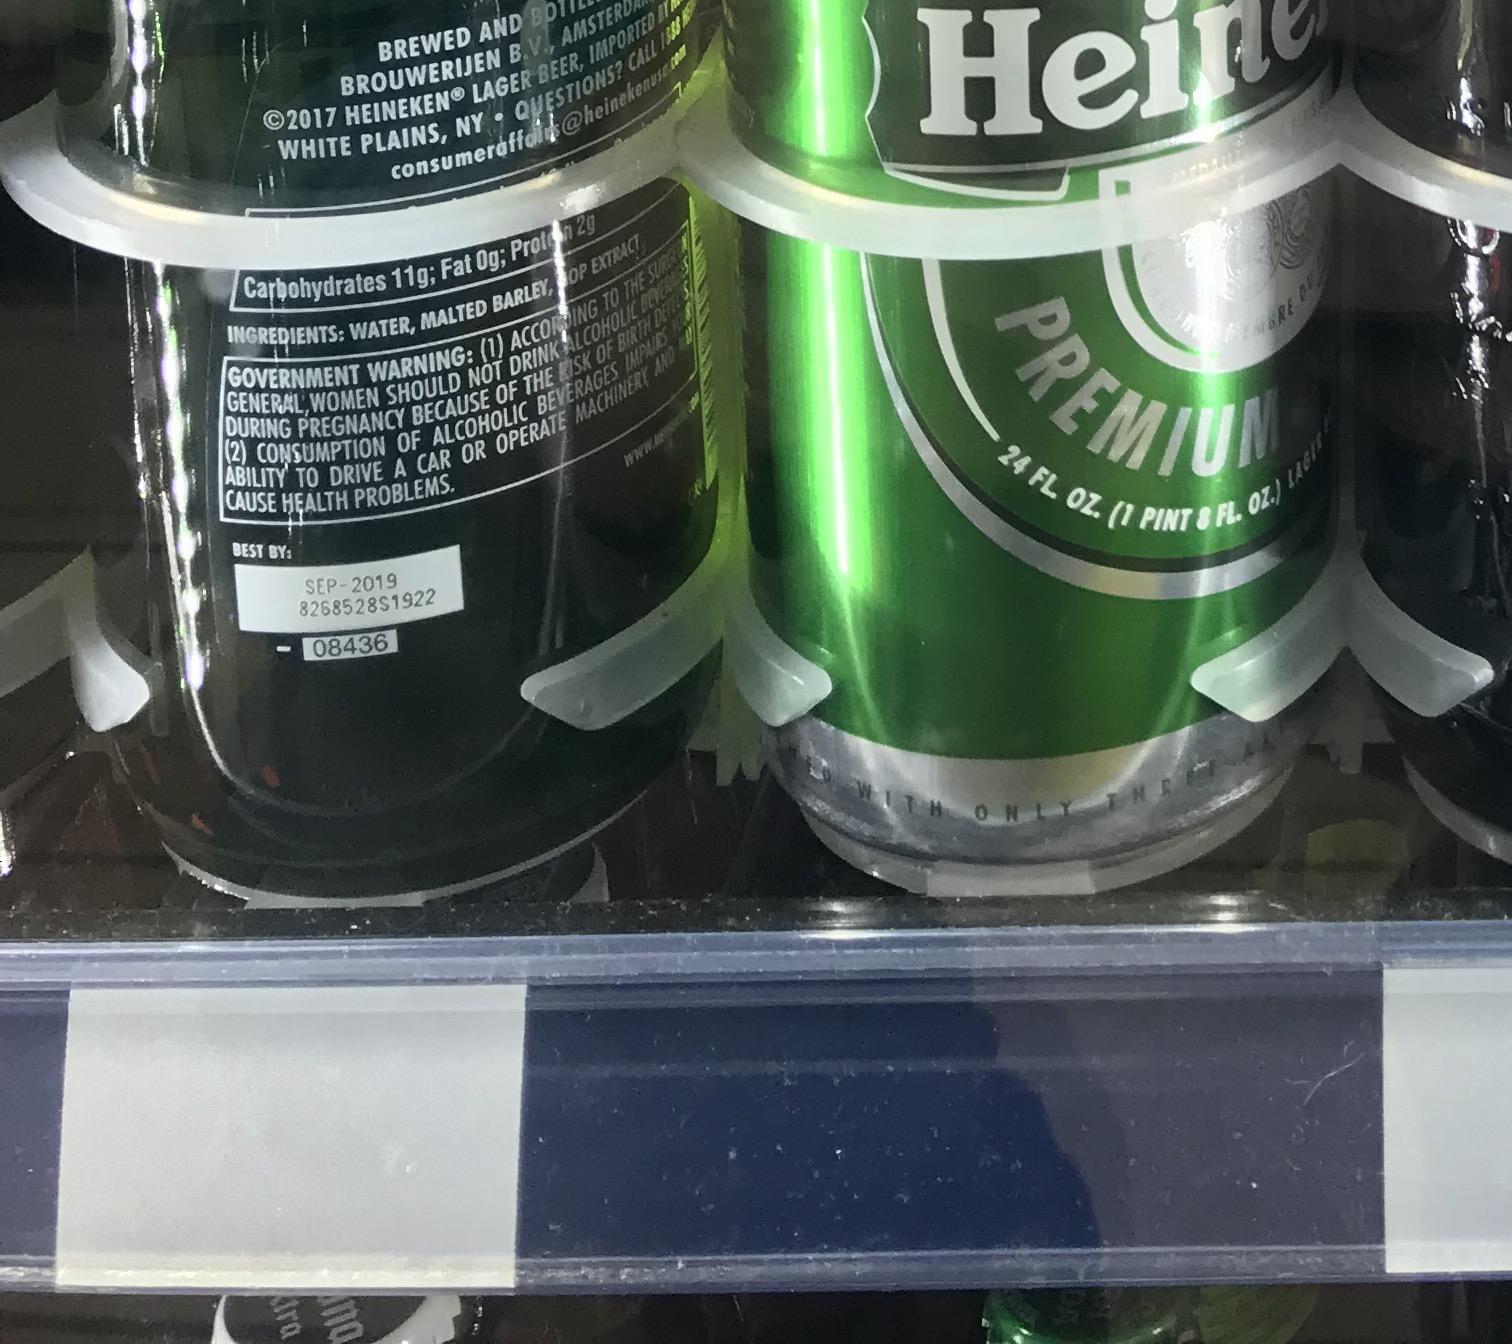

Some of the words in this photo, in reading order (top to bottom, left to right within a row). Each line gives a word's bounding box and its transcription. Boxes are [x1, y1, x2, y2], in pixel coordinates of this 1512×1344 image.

[378, 26, 472, 62] BREWED
[479, 13, 523, 43] AND
[340, 47, 501, 97] BROUWERIJEN
[472, 69, 533, 104] LAGER
[278, 135, 352, 161] WHITE
[360, 121, 448, 155] PLAINS,
[455, 111, 484, 139] NY
[243, 273, 387, 303] Carbohydrates
[441, 253, 473, 280] Fat
[227, 324, 345, 346] INGREDIENTS:
[349, 315, 416, 341] WATER,
[421, 299, 488, 331] MALTED
[228, 363, 361, 390] GOVERNMENT
[367, 344, 474, 384] WARNING:
[310, 386, 380, 414] WOMEN
[386, 371, 461, 406] SHOULD
[468, 360, 503, 390] NOT
[510, 340, 561, 376] DRINK
[994, 296, 1280, 477] PREMIUM
[225, 417, 292, 439] DURING
[299, 407, 406, 439] PREGNANCY
[411, 387, 491, 427] BECAUSE
[522, 366, 555, 396] THE
[256, 435, 386, 464] CONSUMPTION
[432, 400, 529, 447] ALCOHOLIC
[537, 360, 619, 416] BEVERAGES
[225, 465, 288, 488] ABILITY
[329, 460, 384, 486] DRIVE
[416, 447, 452, 475] CAR
[461, 439, 487, 465] OR
[496, 410, 567, 455] OPERATE
[225, 488, 277, 513] CAUSE
[281, 489, 349, 514] HEALTH
[354, 474, 455, 510] PROBLEMS.
[998, 444, 1032, 475] 24
[1028, 466, 1058, 500] FL.
[1066, 487, 1102, 519] OZ.
[1107, 500, 1135, 530] (1
[1139, 506, 1193, 532] PINT
[1216, 501, 1242, 527] FL.
[305, 572, 398, 596] SEP-2019
[312, 633, 389, 658] 08436
[975, 799, 1073, 824] ONLY
